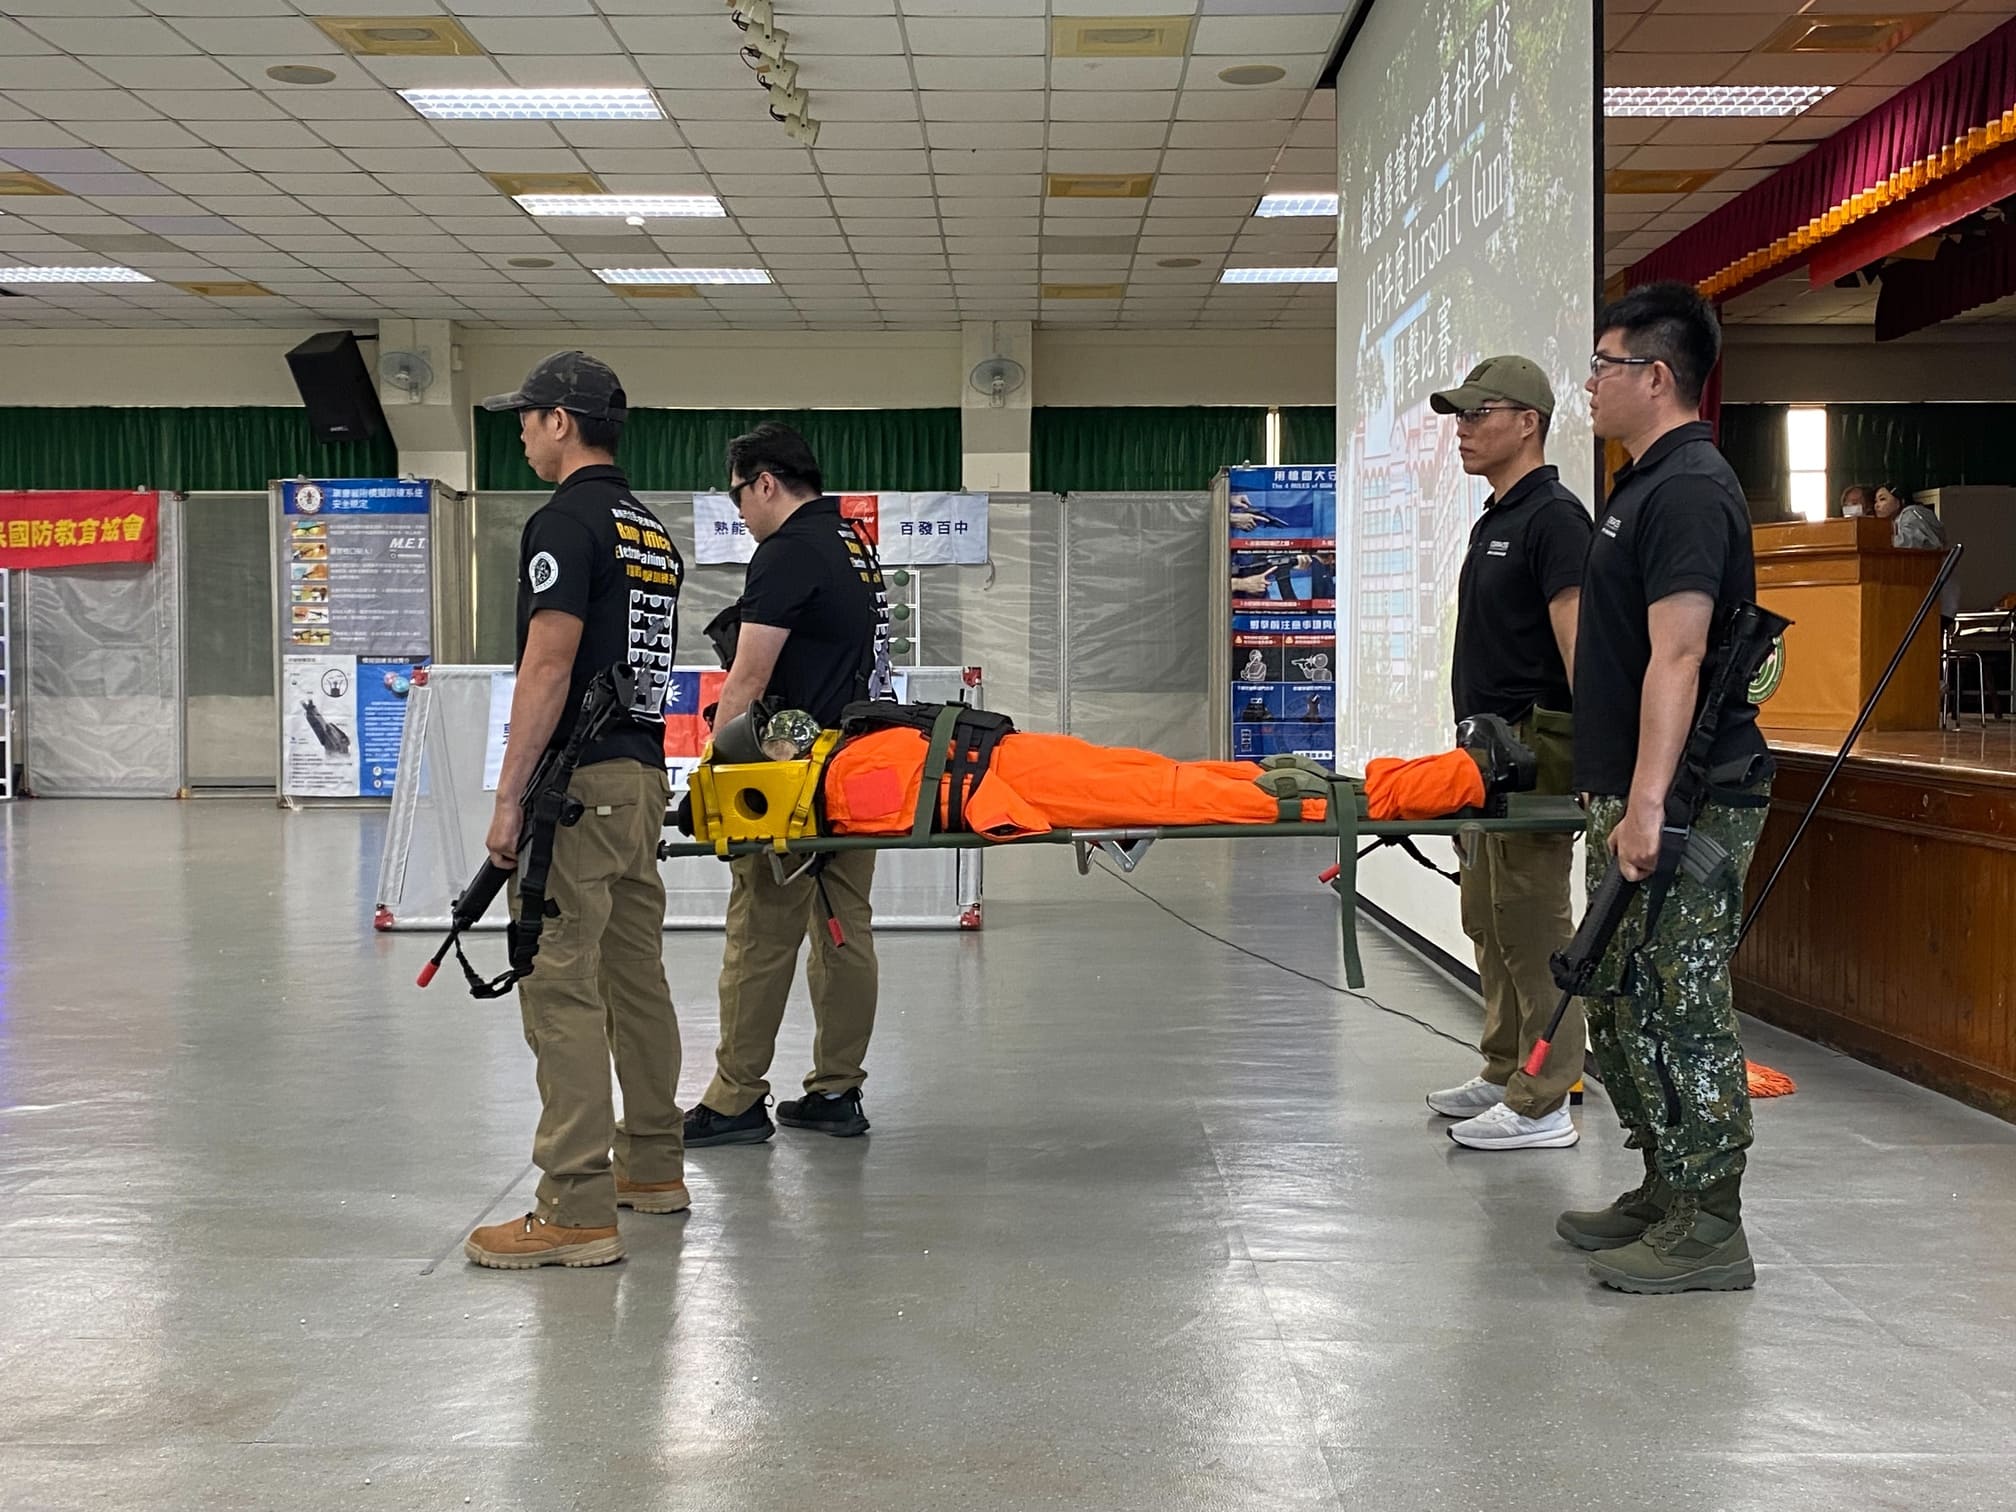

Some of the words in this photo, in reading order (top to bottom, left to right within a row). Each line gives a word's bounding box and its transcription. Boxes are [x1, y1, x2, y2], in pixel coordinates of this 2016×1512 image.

[1472, 150, 1503, 228] Gun
[1394, 294, 1453, 406] 射擊比賽
[900, 519, 969, 536] 百發百中
